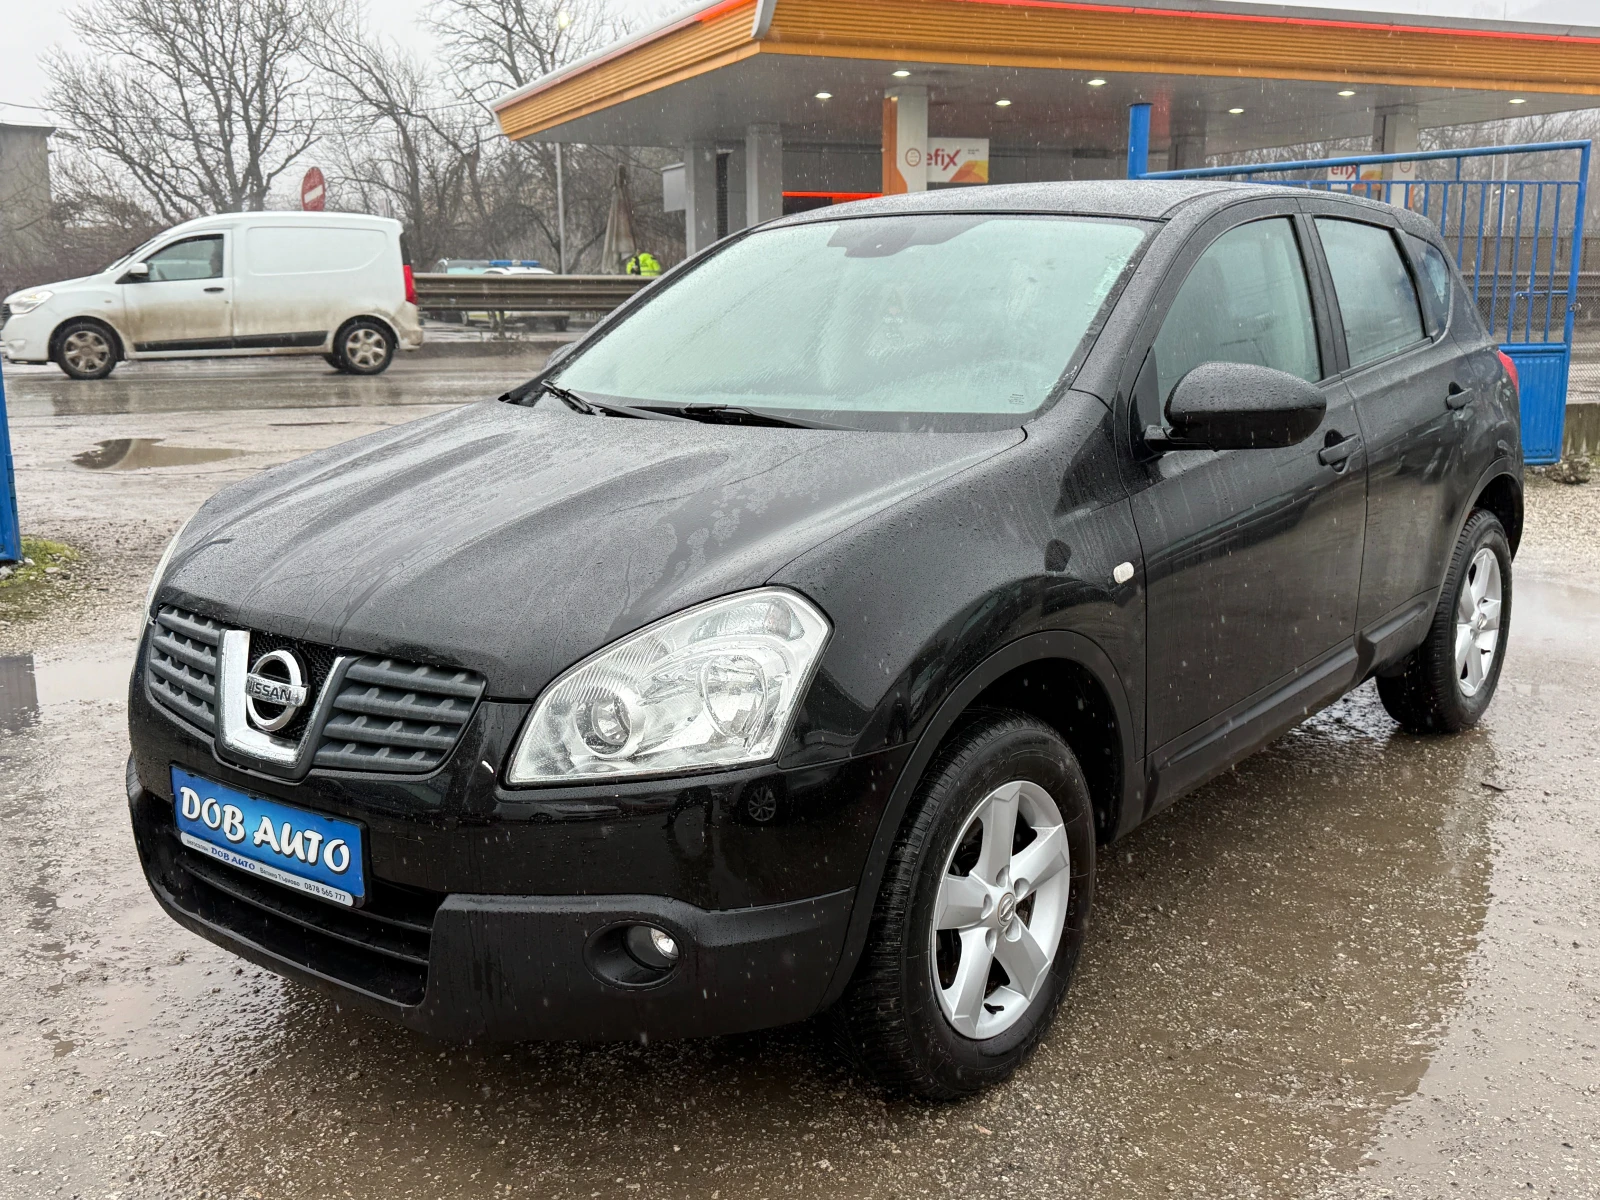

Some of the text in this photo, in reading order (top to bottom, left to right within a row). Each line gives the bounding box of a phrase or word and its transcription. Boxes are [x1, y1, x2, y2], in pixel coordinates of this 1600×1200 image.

[247, 680, 292, 701] NISSAN
[180, 786, 351, 873] DOB AUTO
[211, 847, 230, 861] DOB
[231, 856, 256, 871] AUTO
[304, 882, 320, 893] 0878
[334, 892, 346, 902] 777
